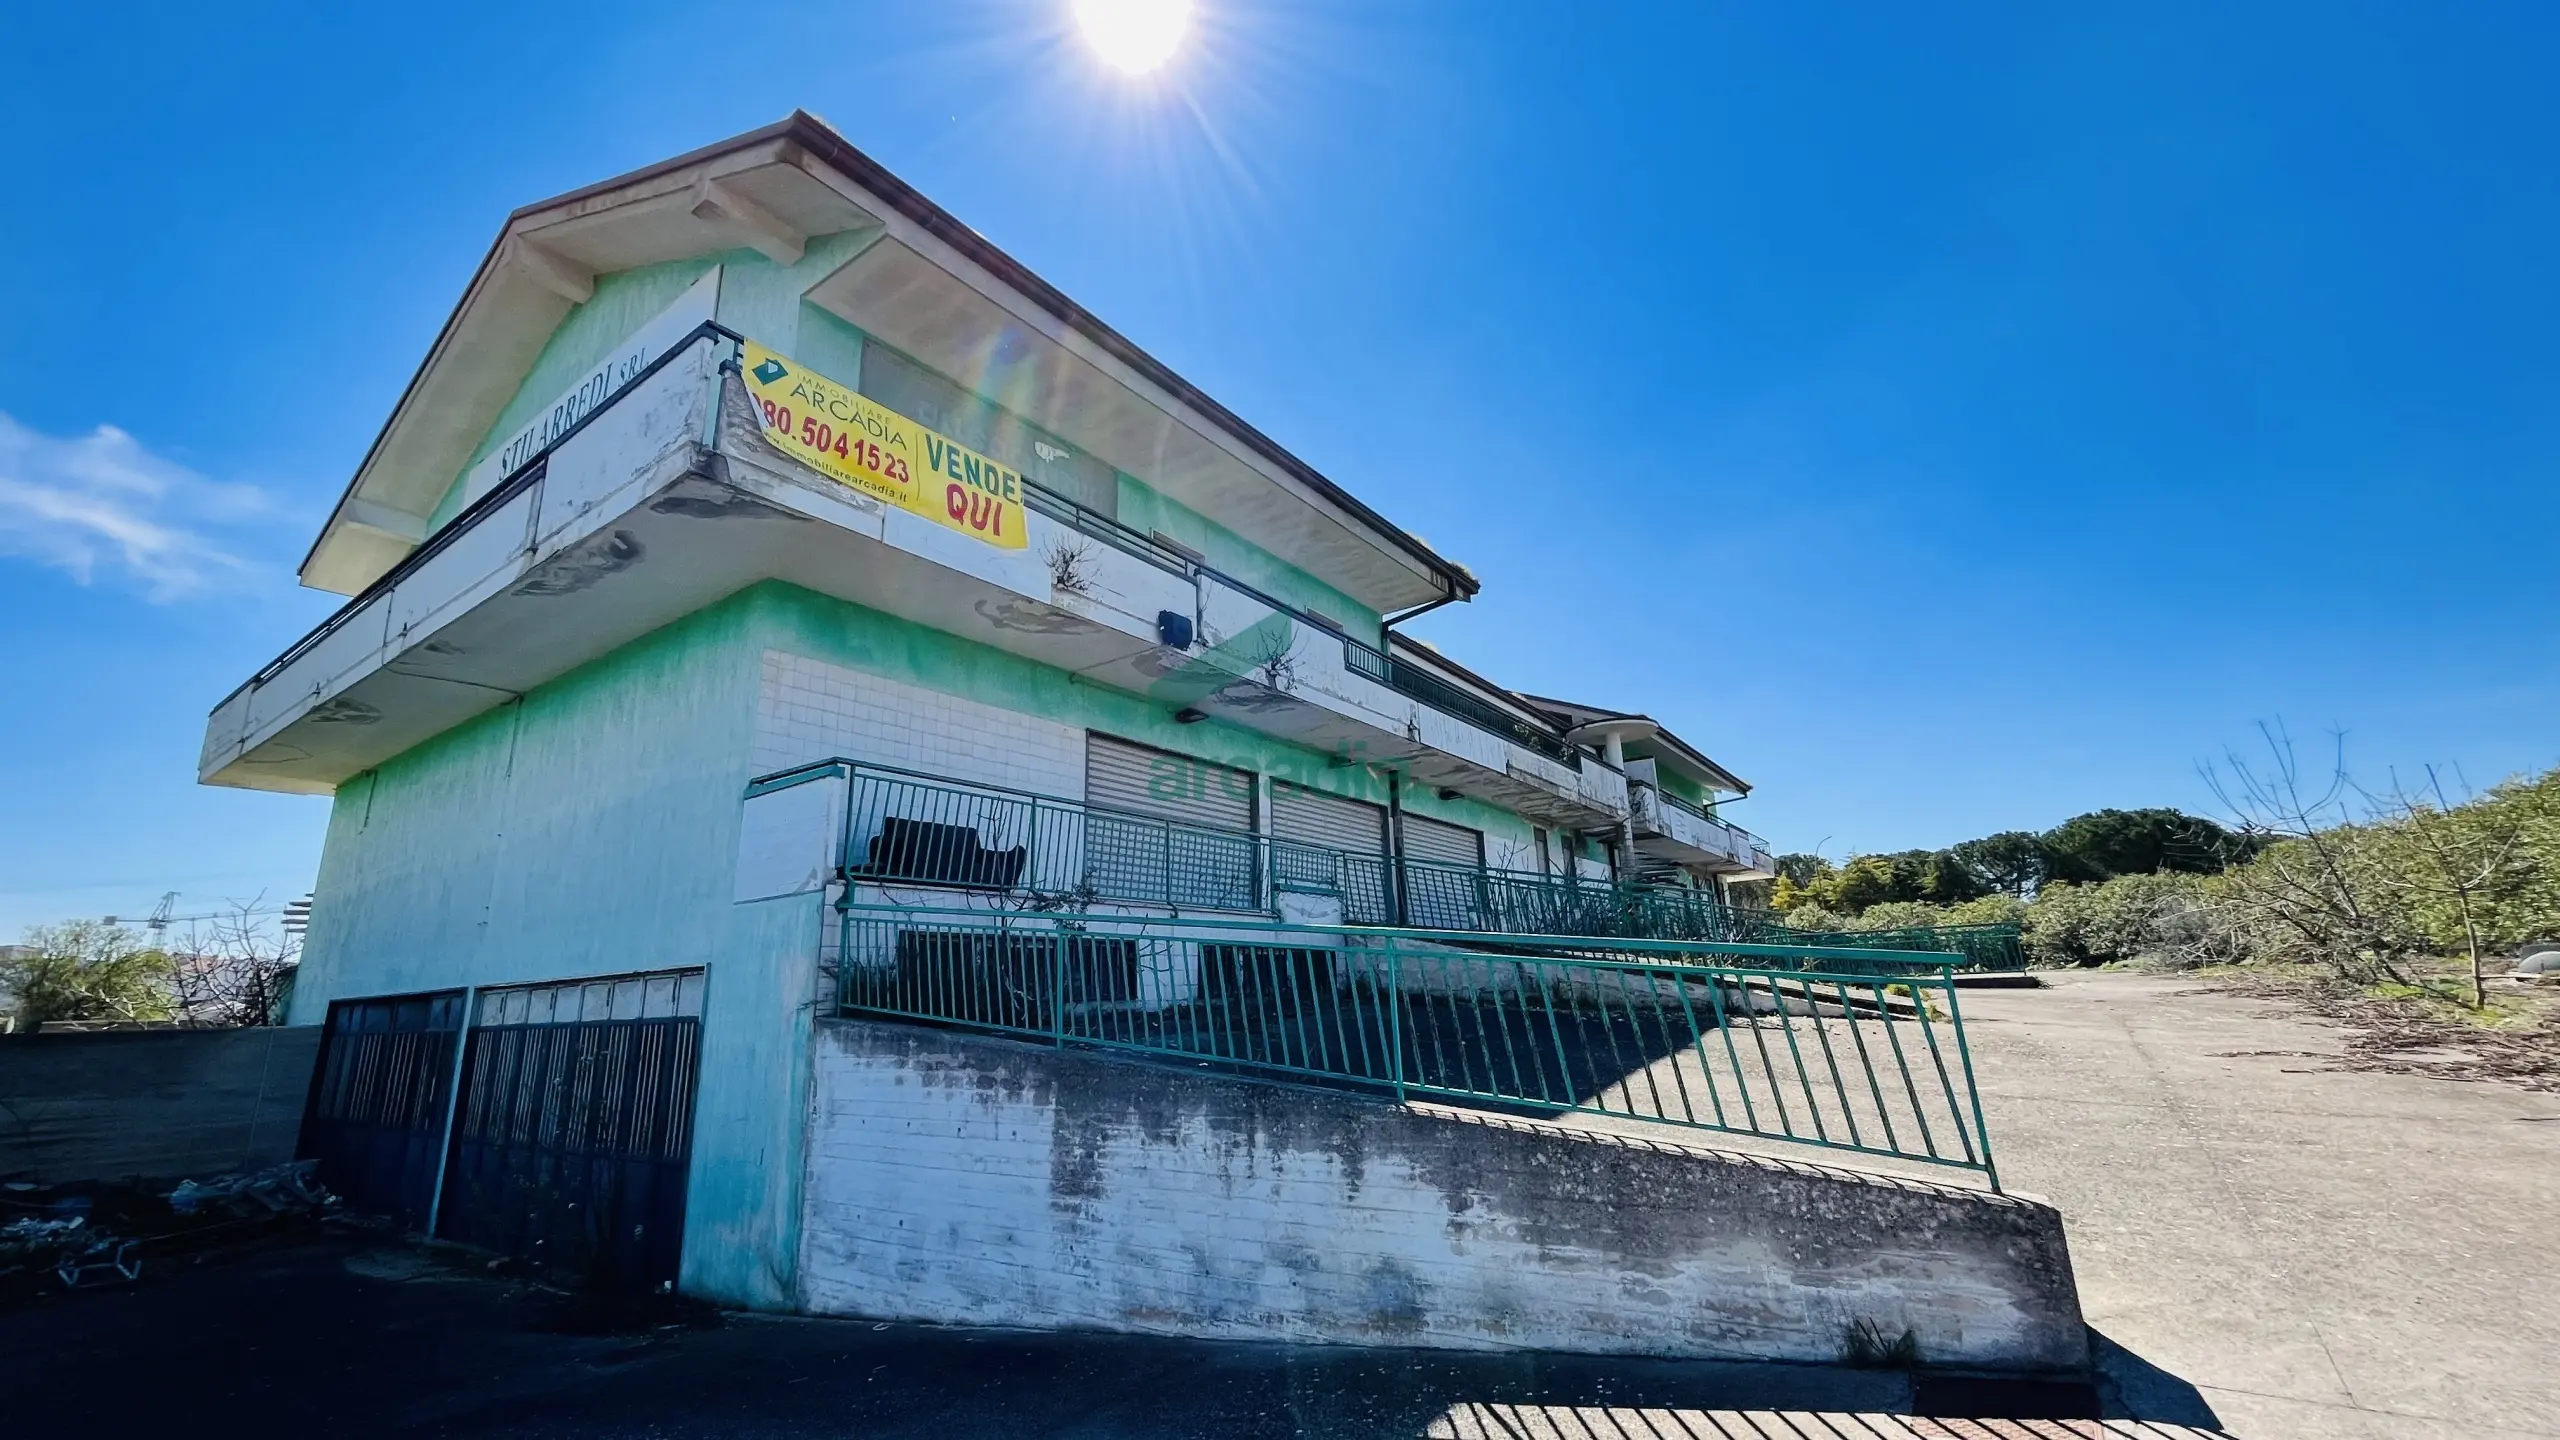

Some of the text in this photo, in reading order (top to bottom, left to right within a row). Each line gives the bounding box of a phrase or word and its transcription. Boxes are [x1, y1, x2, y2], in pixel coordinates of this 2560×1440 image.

[789, 383, 908, 451] ARCADIA
[796, 373, 892, 425] IMMOBILIARE
[925, 433, 1019, 506] VENDE
[946, 483, 1003, 537] QUI
